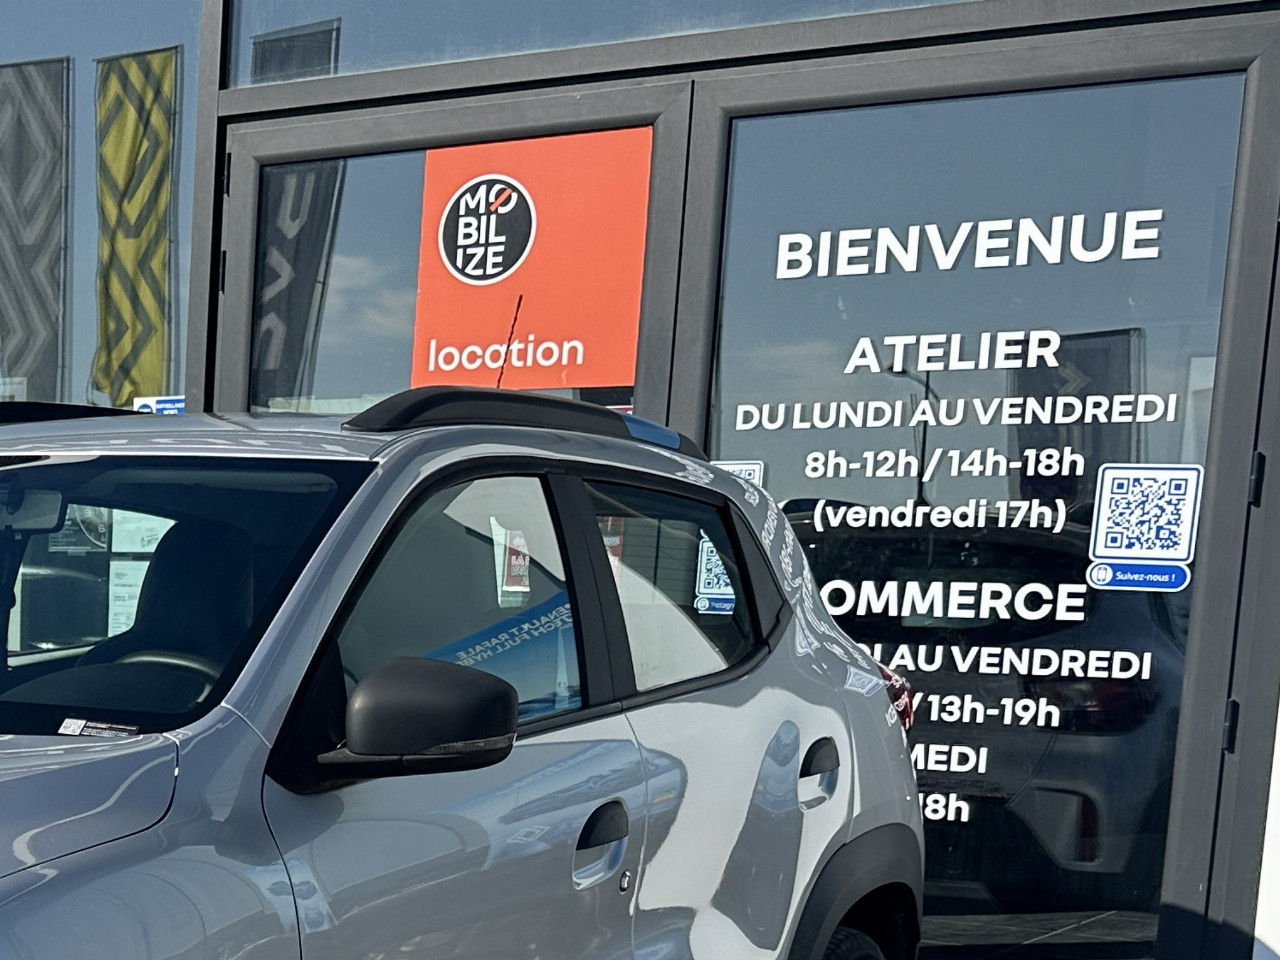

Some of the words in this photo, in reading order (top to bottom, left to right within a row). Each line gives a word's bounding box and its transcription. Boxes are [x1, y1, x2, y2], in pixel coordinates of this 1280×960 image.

[775, 209, 1163, 279] BIENVENUE
[428, 334, 584, 371] location
[844, 329, 1061, 374] ATELIER
[735, 404, 786, 431] DU
[791, 400, 902, 429] LUNDI
[909, 398, 965, 427] AU
[972, 393, 1177, 425] VENDREDI
[804, 449, 918, 479] 8h-12h
[948, 446, 1084, 477] 14h-18h
[813, 497, 986, 532] (vendredi
[995, 500, 1067, 533] 17h)
[1116, 572, 1169, 582] Suivez-nous
[820, 579, 1086, 621] OMMERCE
[888, 644, 944, 672] AU
[950, 646, 1152, 680] VENDREDI
[927, 694, 1060, 727] 13h-19h
